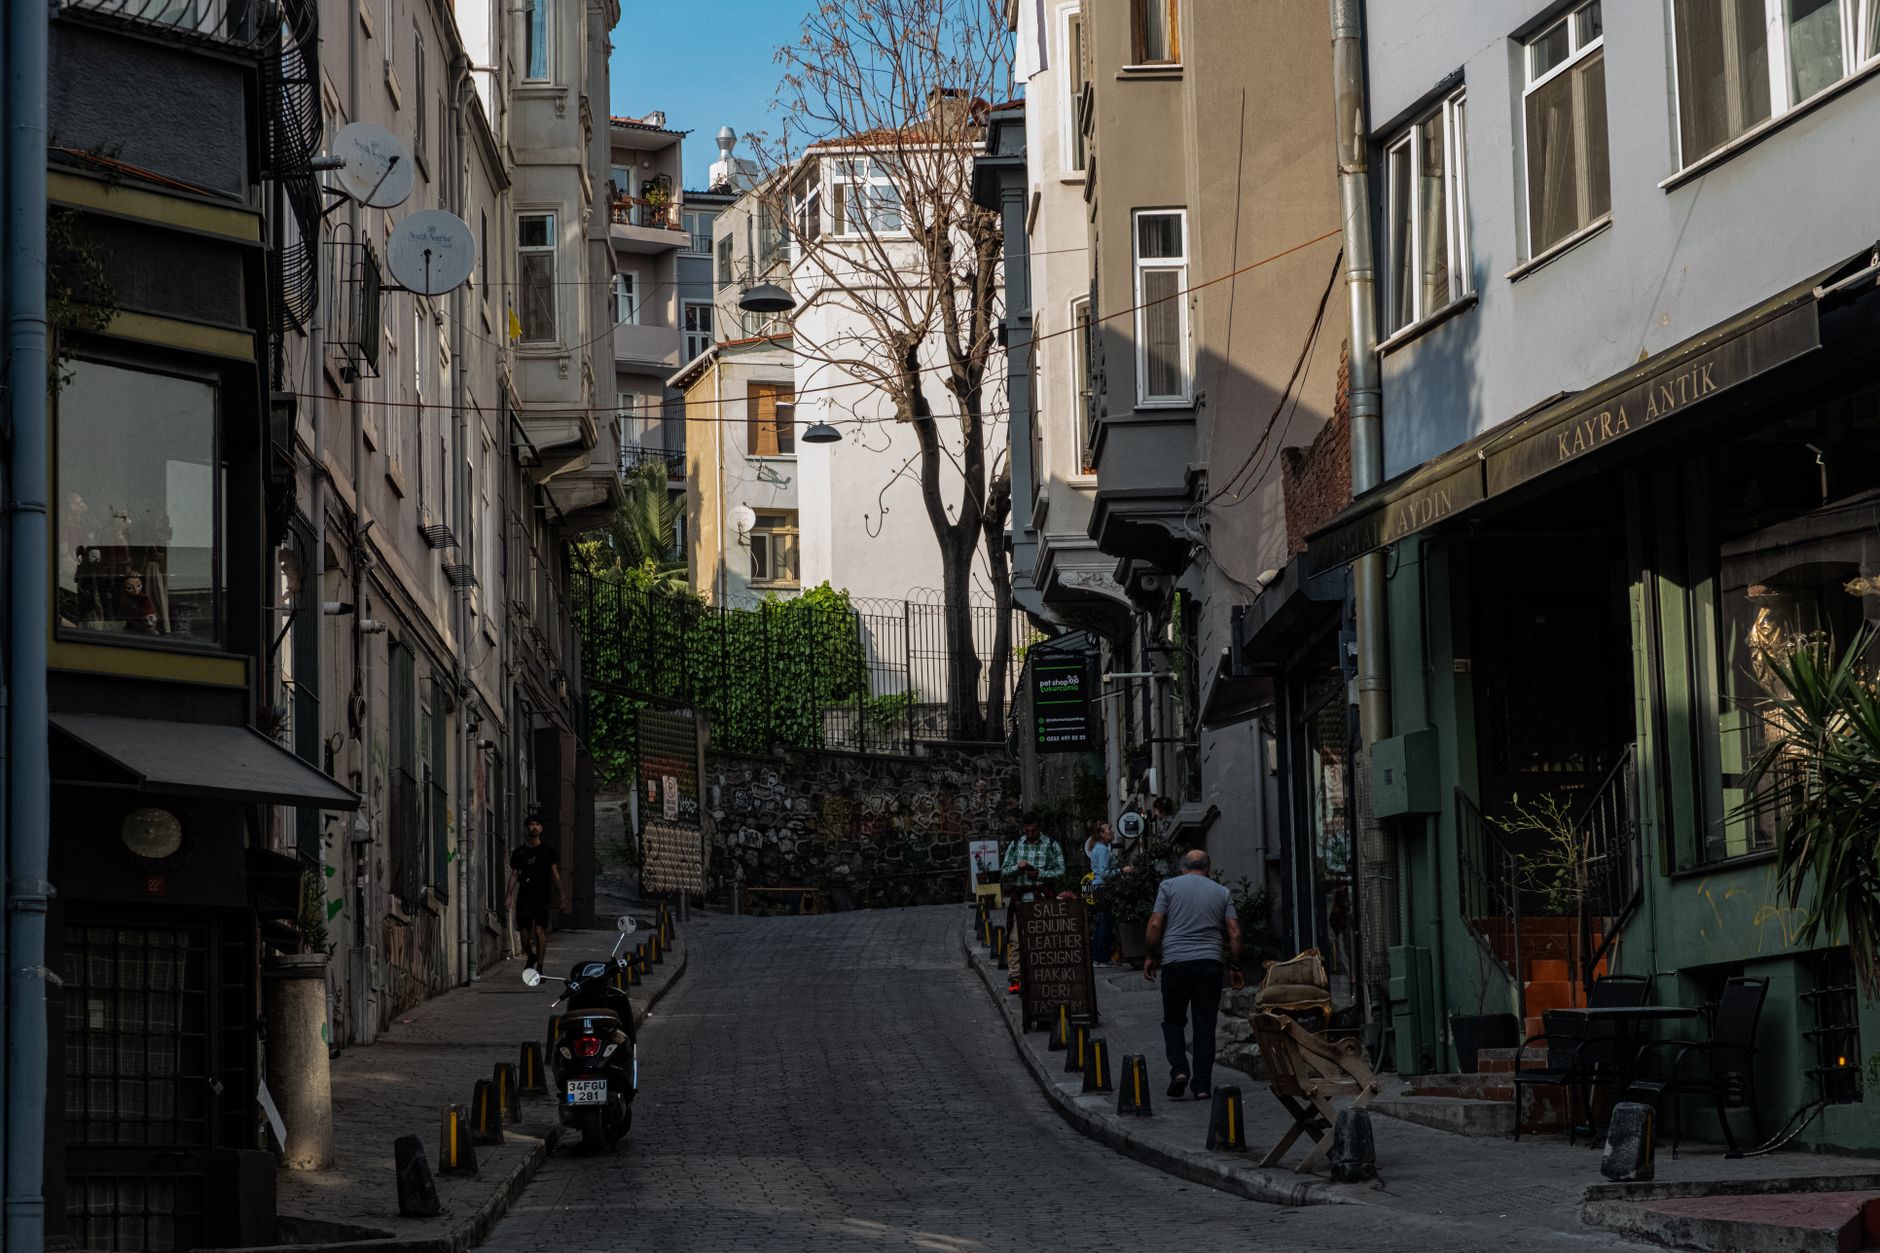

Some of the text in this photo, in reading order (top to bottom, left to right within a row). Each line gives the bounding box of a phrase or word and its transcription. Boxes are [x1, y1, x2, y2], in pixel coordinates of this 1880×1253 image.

[1557, 361, 1718, 461] KAYRA ANTİK
[1398, 486, 1453, 534] AYDIN
[1040, 678, 1069, 688] pet shop
[148, 879, 160, 891] 22
[1034, 903, 1067, 918] SALE
[1027, 918, 1077, 934] GENUINE
[1027, 934, 1082, 950] LEATHER
[1030, 950, 1082, 965] DESIGNS
[569, 1081, 606, 1091] 34FGU
[579, 1091, 599, 1101] 281
